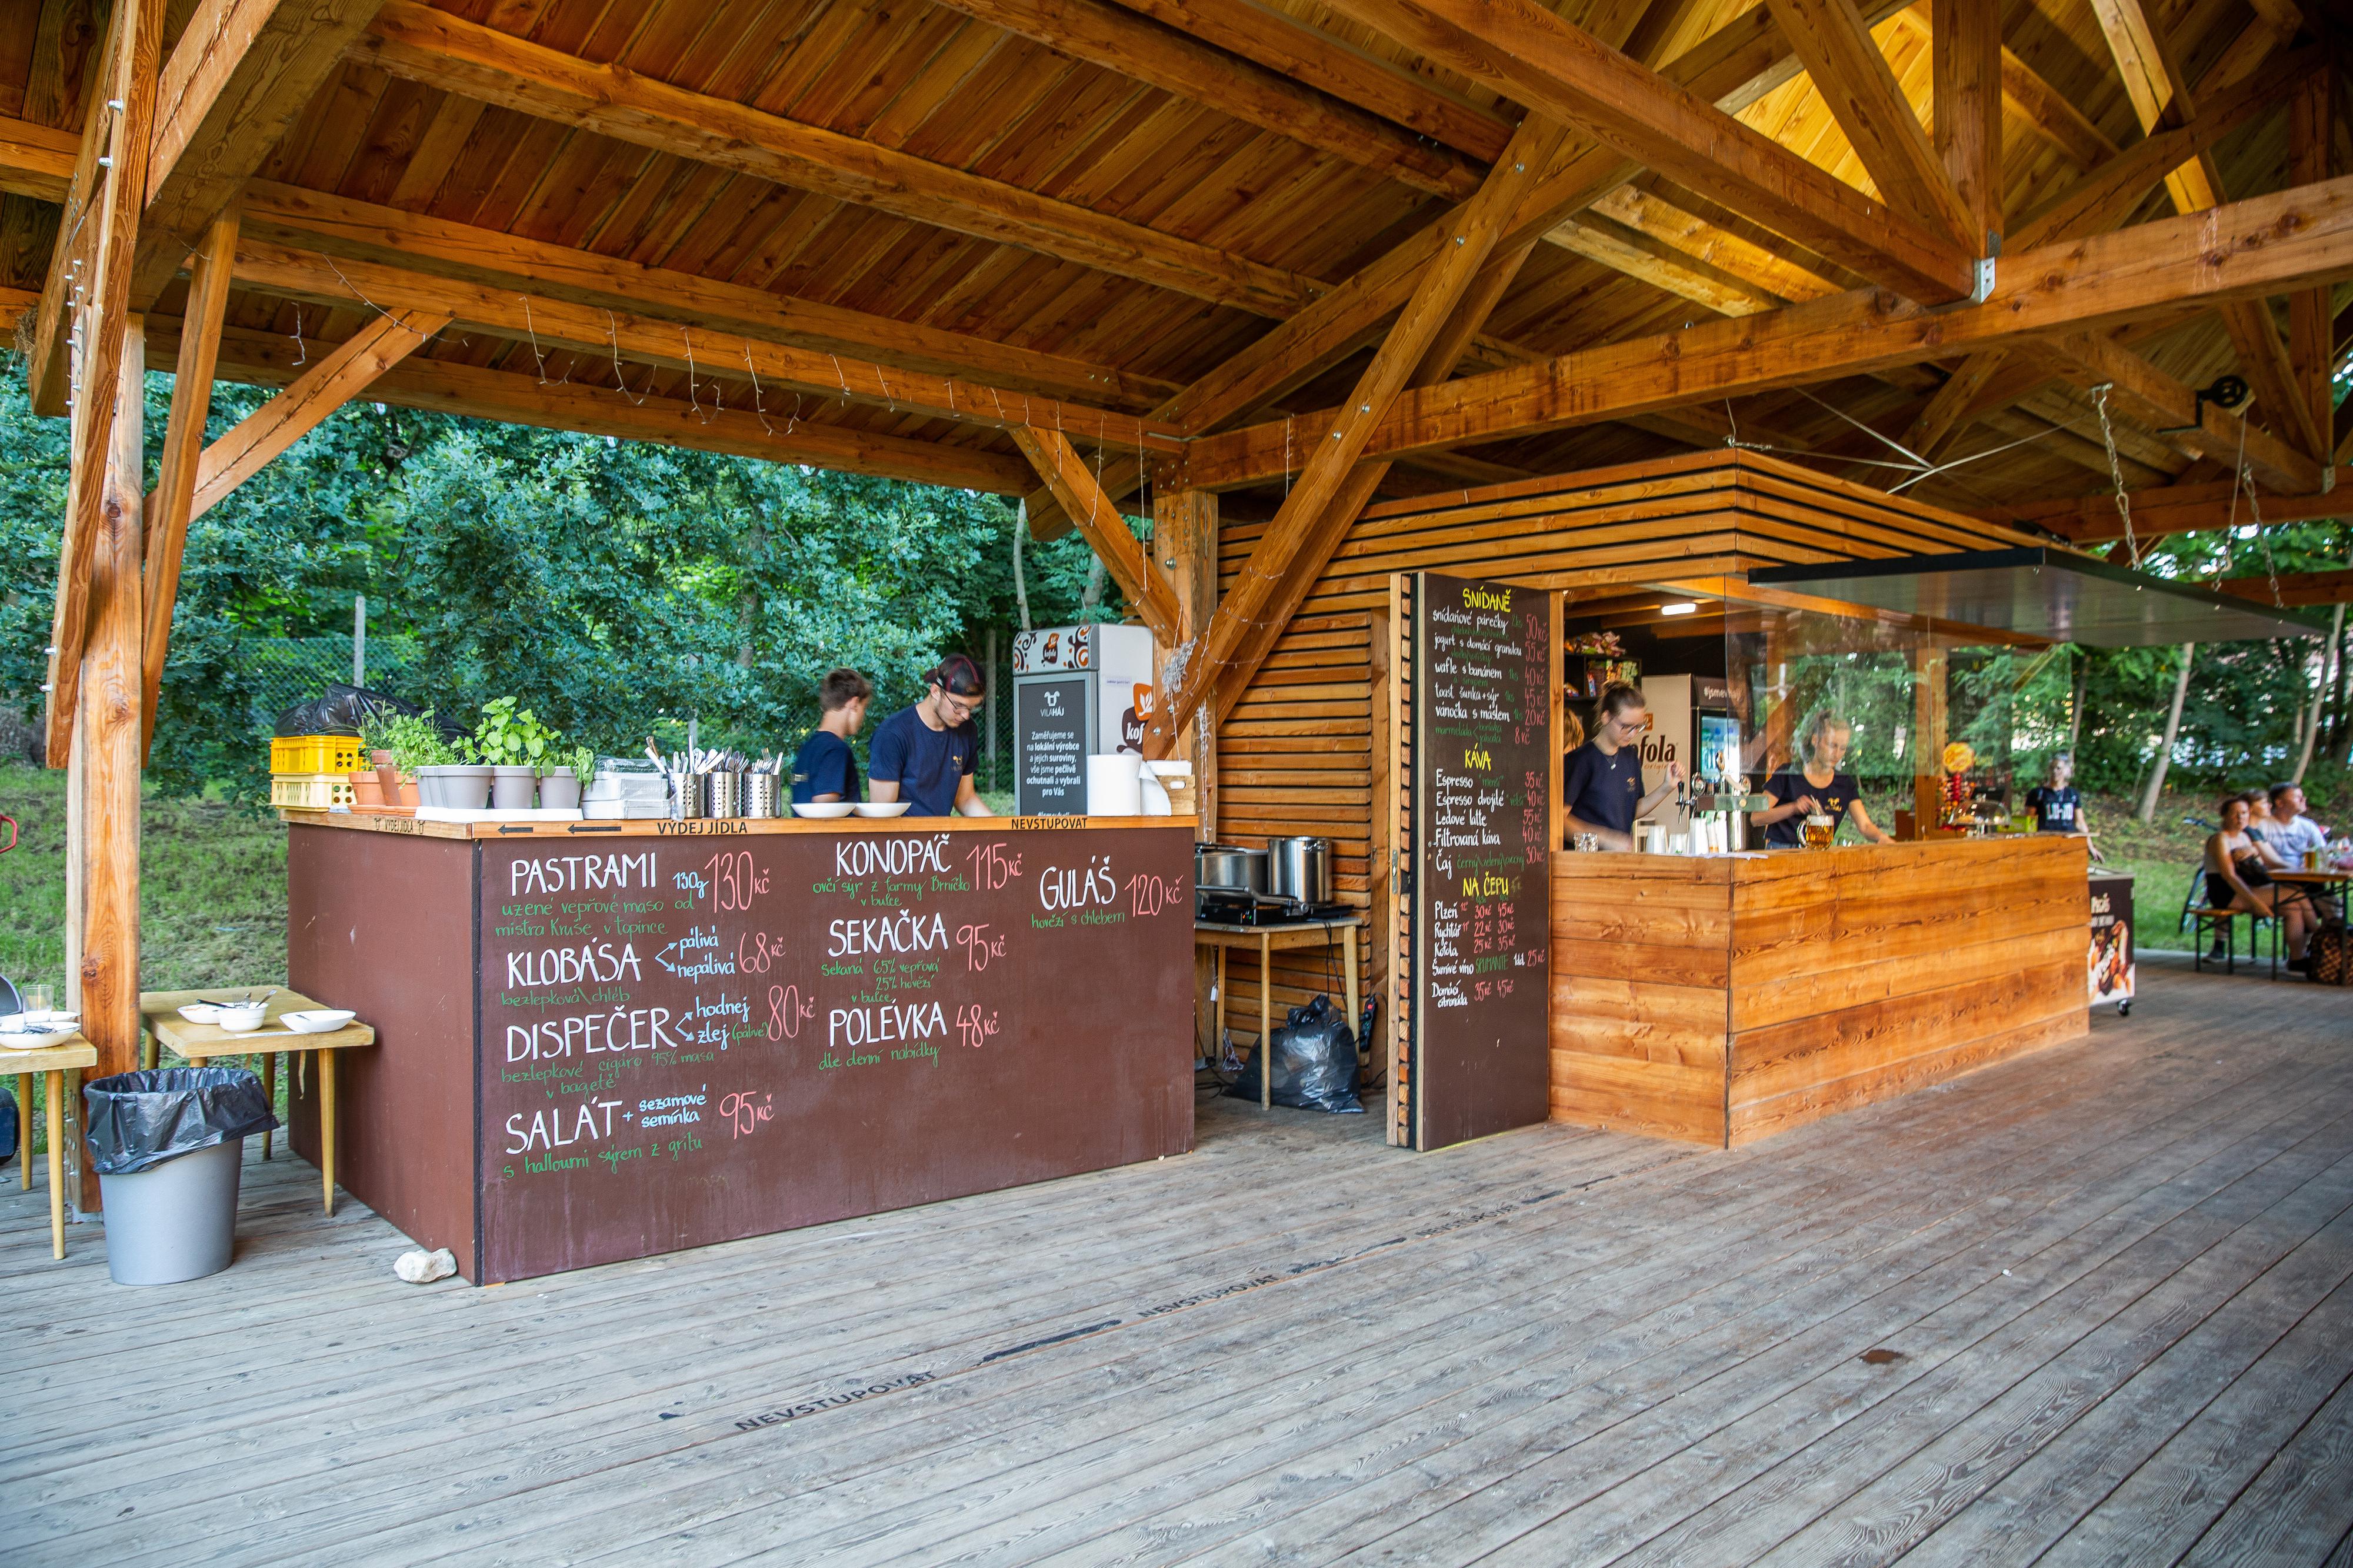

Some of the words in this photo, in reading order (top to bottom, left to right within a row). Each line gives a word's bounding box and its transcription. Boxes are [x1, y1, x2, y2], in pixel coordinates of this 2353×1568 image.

[1463, 586, 1511, 612] SNÍDANĚ
[1434, 632, 1455, 652] jogurt
[1435, 658, 1457, 675] wafle
[1469, 662, 1502, 679] banánem
[1435, 682, 1454, 699] toast
[1435, 701, 1467, 719] vánočka
[1472, 710, 1477, 719] s
[1481, 705, 1510, 722] máslem
[1126, 722, 1145, 745] kof
[1034, 753, 1048, 764] jejich
[1035, 742, 1055, 751] lokální
[1055, 742, 1080, 752] výrobce
[1465, 742, 1491, 771] KÁVA
[1639, 735, 1675, 769] fola
[1026, 776, 1054, 785] ochutnali
[1059, 776, 1081, 786] vybrali
[1031, 765, 1040, 773] vše
[1041, 766, 1054, 775] jsme
[1055, 764, 1076, 775] pečlivě
[1436, 768, 1473, 795] Espresso
[1042, 788, 1052, 798] pro
[1054, 787, 1065, 796] Vás
[1436, 791, 1472, 813] Espresso
[657, 820, 703, 835] VÝDEJ
[707, 819, 747, 834] JÍDLA
[1011, 818, 1087, 829] NEVSTUPOVAT
[1436, 809, 1465, 825] Ledové
[1469, 808, 1487, 826] latte
[1436, 828, 1479, 847] Filtrovaná
[1482, 828, 1501, 845] káva
[836, 833, 952, 877] KONOPÁČ
[1437, 848, 1452, 880] Čaj
[512, 852, 656, 896] PASTRAMI
[672, 871, 709, 899] 130g
[812, 877, 840, 895] ovčí
[841, 879, 863, 900] sýr
[871, 880, 878, 892] z
[886, 875, 926, 901] farmy
[931, 873, 971, 892] Brníčko
[1039, 855, 1116, 911] GULÁŠ
[1463, 877, 1479, 897] NA
[1484, 871, 1509, 897] ČEPU
[502, 896, 554, 917] uzené
[561, 894, 619, 921] vepřové
[623, 900, 664, 913] maso
[674, 890, 695, 910] od
[861, 898, 866, 907] v
[1435, 900, 1458, 920] Plzeň
[495, 919, 544, 937] mistra
[550, 918, 594, 936] Kruše
[604, 924, 612, 934] v
[614, 916, 668, 943] topince
[1031, 910, 1069, 929] hovězí
[1071, 915, 1077, 925] s
[1081, 908, 1125, 926] chlebem
[679, 925, 719, 959] pálivá
[827, 908, 949, 958] SEKAČKA
[507, 937, 642, 989] KLOBÁSA
[1434, 942, 1458, 958] Kofola
[677, 952, 735, 985] nepálivá
[899, 957, 941, 980] vepřová
[1459, 959, 1474, 974] víno
[900, 974, 935, 989] hovězí
[695, 993, 751, 1023] hodnej
[851, 994, 857, 1003] v
[506, 1005, 679, 1063] DISPEČER
[698, 1020, 729, 1050] zlej
[829, 998, 948, 1047] POLÉVKA
[501, 1061, 584, 1086] bezlepkové
[598, 1053, 642, 1078] cigáro
[652, 1050, 678, 1067] 95%
[681, 1052, 714, 1062] masa
[818, 1050, 842, 1070] dle
[846, 1049, 884, 1067] denní
[891, 1040, 942, 1068] nabídky
[546, 1090, 554, 1099] v
[561, 1073, 616, 1105] bagetě
[505, 1096, 623, 1155] SALÁT
[638, 1083, 707, 1112] sezamové
[641, 1108, 701, 1128] semínka
[504, 1165, 514, 1178] s
[525, 1149, 589, 1174] halloumi
[598, 1144, 642, 1175] sýrem
[651, 1143, 661, 1157] z
[733, 1370, 936, 1432] NEVSTUPOVAT
